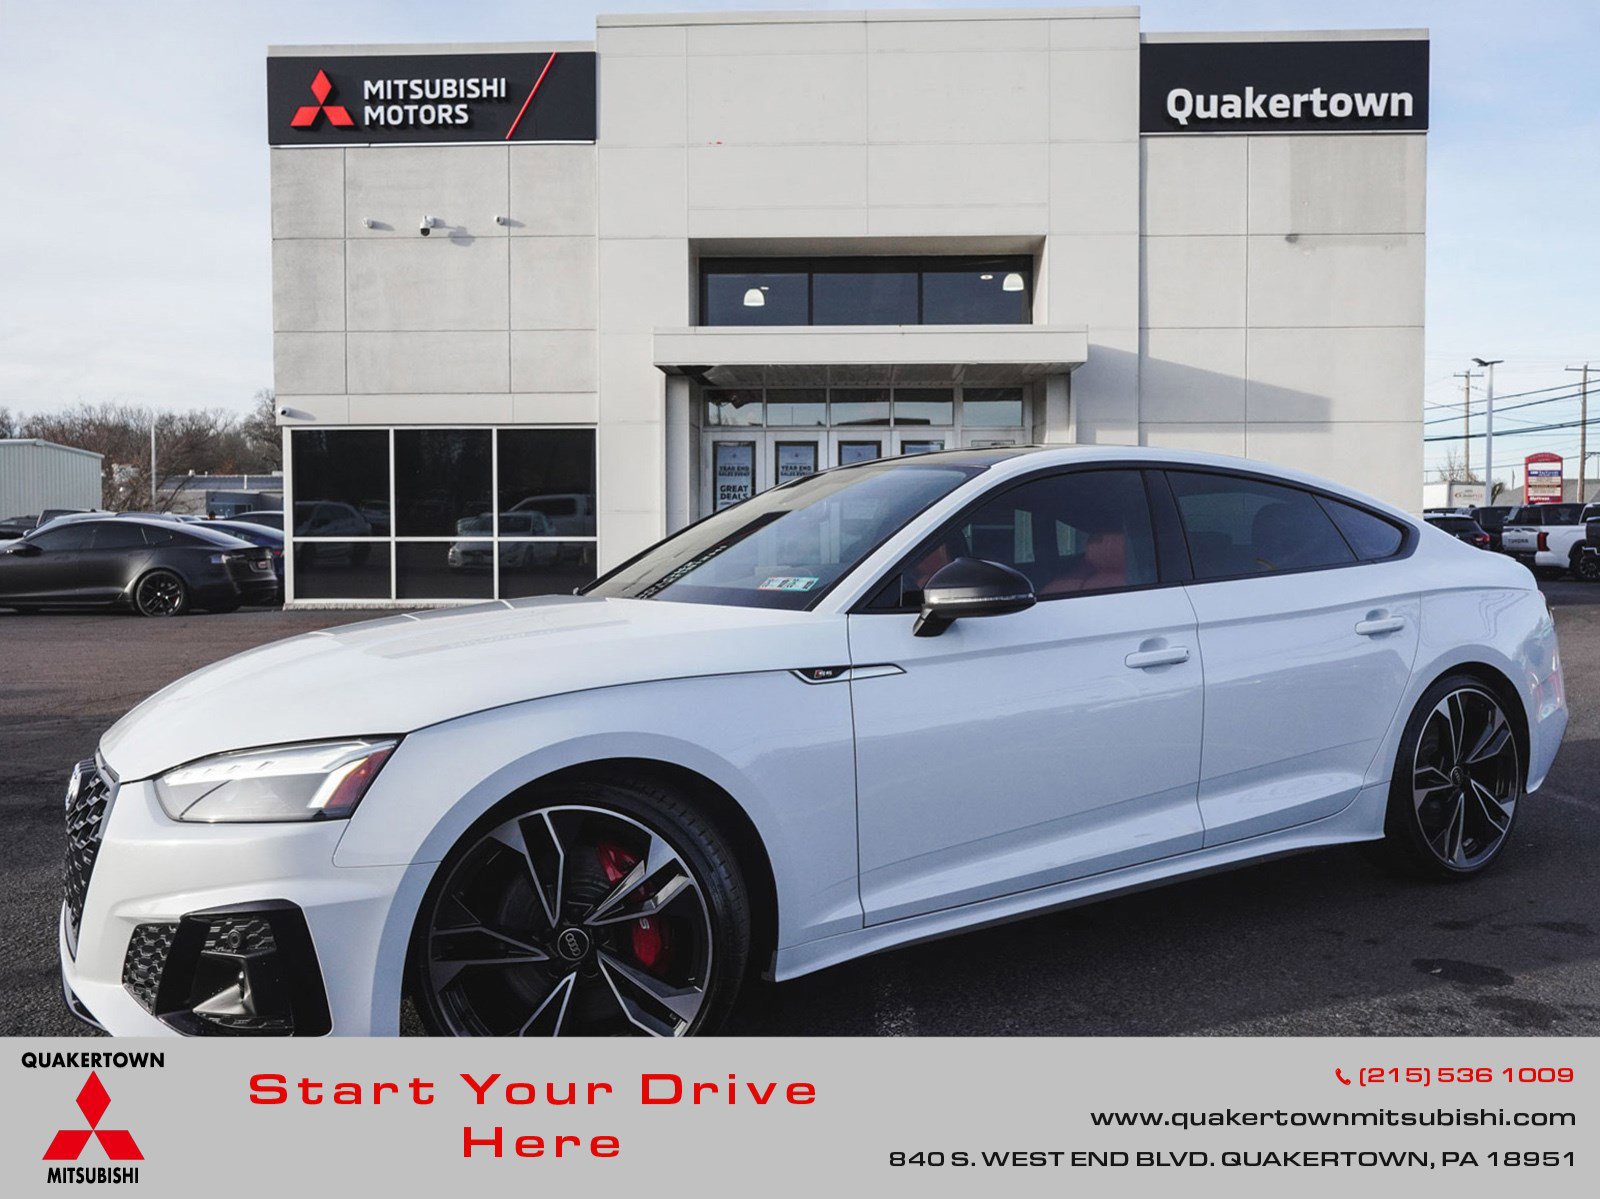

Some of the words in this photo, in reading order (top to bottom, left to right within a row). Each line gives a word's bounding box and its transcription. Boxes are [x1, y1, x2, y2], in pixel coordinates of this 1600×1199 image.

[363, 77, 506, 100] MITSUBISHI
[364, 103, 469, 126] MOTORS
[1166, 86, 1413, 125] Quakertown
